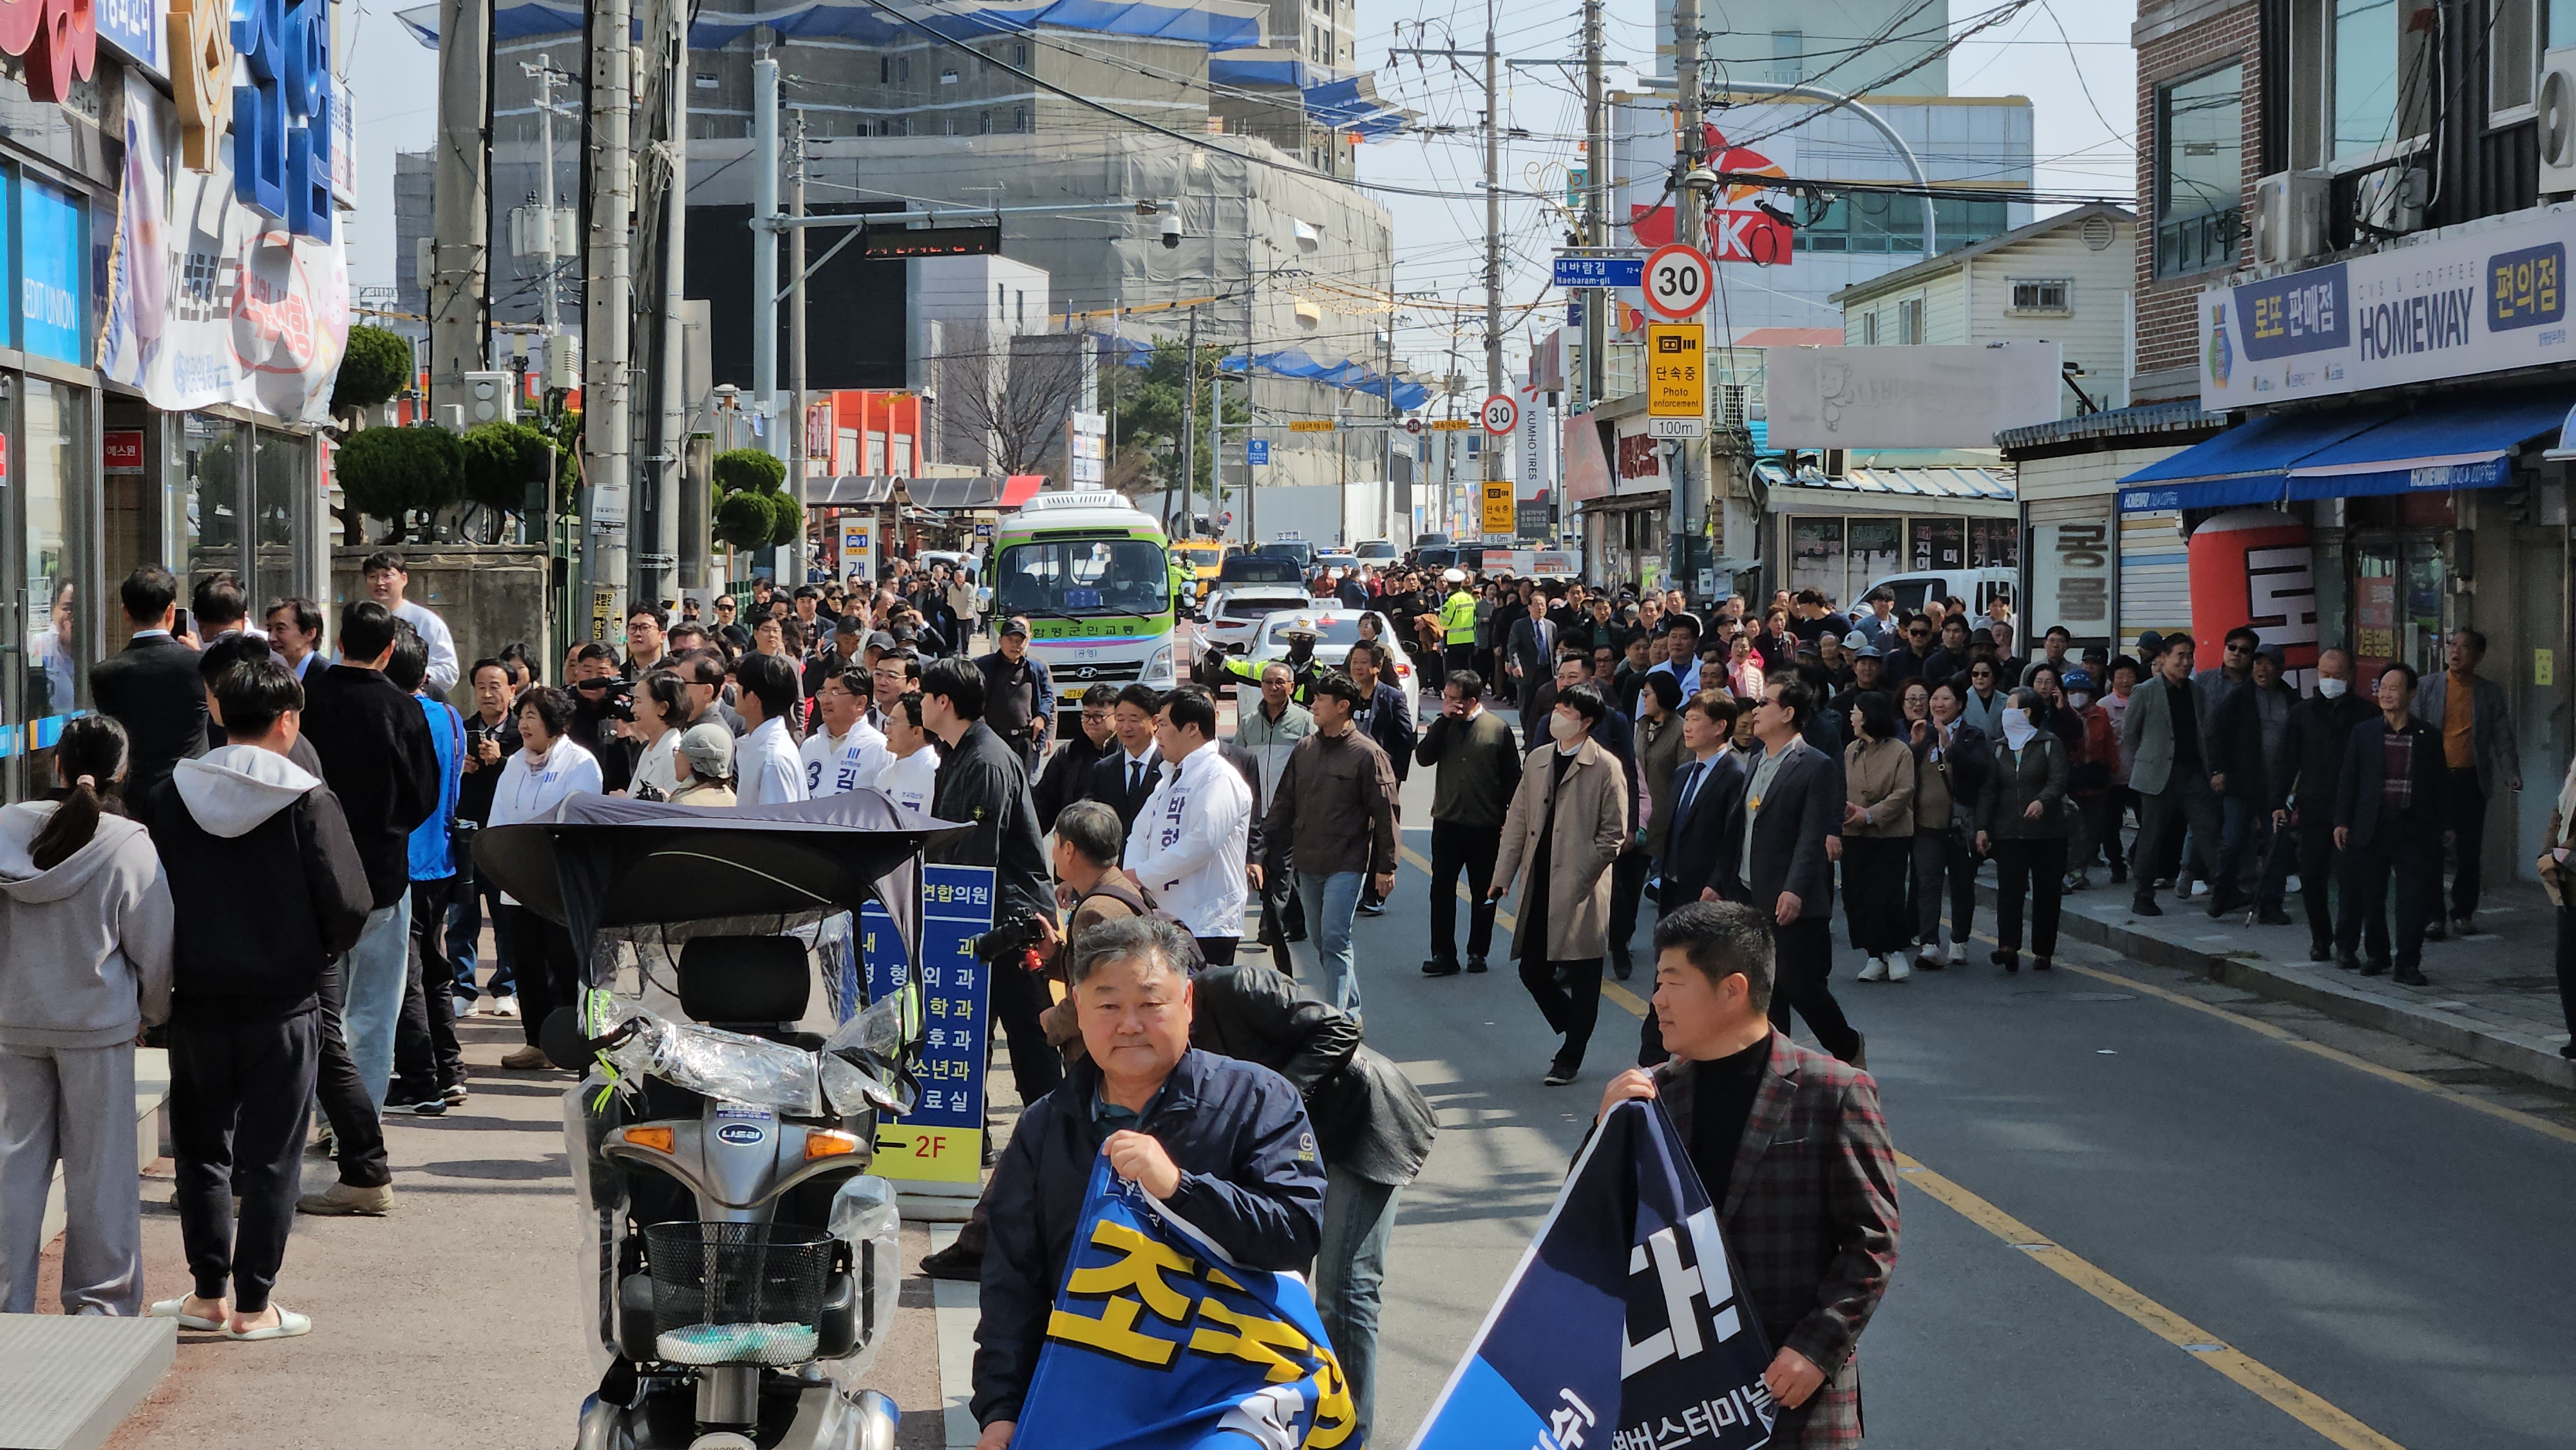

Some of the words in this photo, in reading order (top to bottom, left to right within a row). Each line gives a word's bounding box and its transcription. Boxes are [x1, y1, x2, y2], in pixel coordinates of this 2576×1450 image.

[1557, 261, 1605, 275] 내바람길
[1557, 276, 1611, 285] Naebaram-gil
[1658, 266, 1698, 297] 30
[2358, 280, 2383, 300] CVS
[2416, 261, 2475, 288] COFFEE
[2496, 254, 2557, 319] 편의점
[46, 285, 75, 331] UNION
[2255, 295, 2284, 339] 로또
[2288, 281, 2334, 337] 판매점
[2360, 287, 2474, 362] HOMEWAY
[1656, 365, 1696, 381] 단속중
[1663, 387, 1689, 397] Photo
[1653, 400, 1700, 408] enforcement
[1489, 407, 1510, 424] 30
[1527, 410, 1537, 450] KUMHO
[1659, 421, 1693, 435] 100m
[106, 445, 136, 457] 에스원
[1528, 453, 1537, 480] TIRES
[2410, 466, 2453, 487] HOMEWAY
[1486, 504, 1509, 514] 단속중
[1033, 625, 1134, 638] 함평군민교통
[1074, 649, 1097, 659] (공영)
[806, 761, 822, 791] 3
[915, 1135, 947, 1159] 2F
